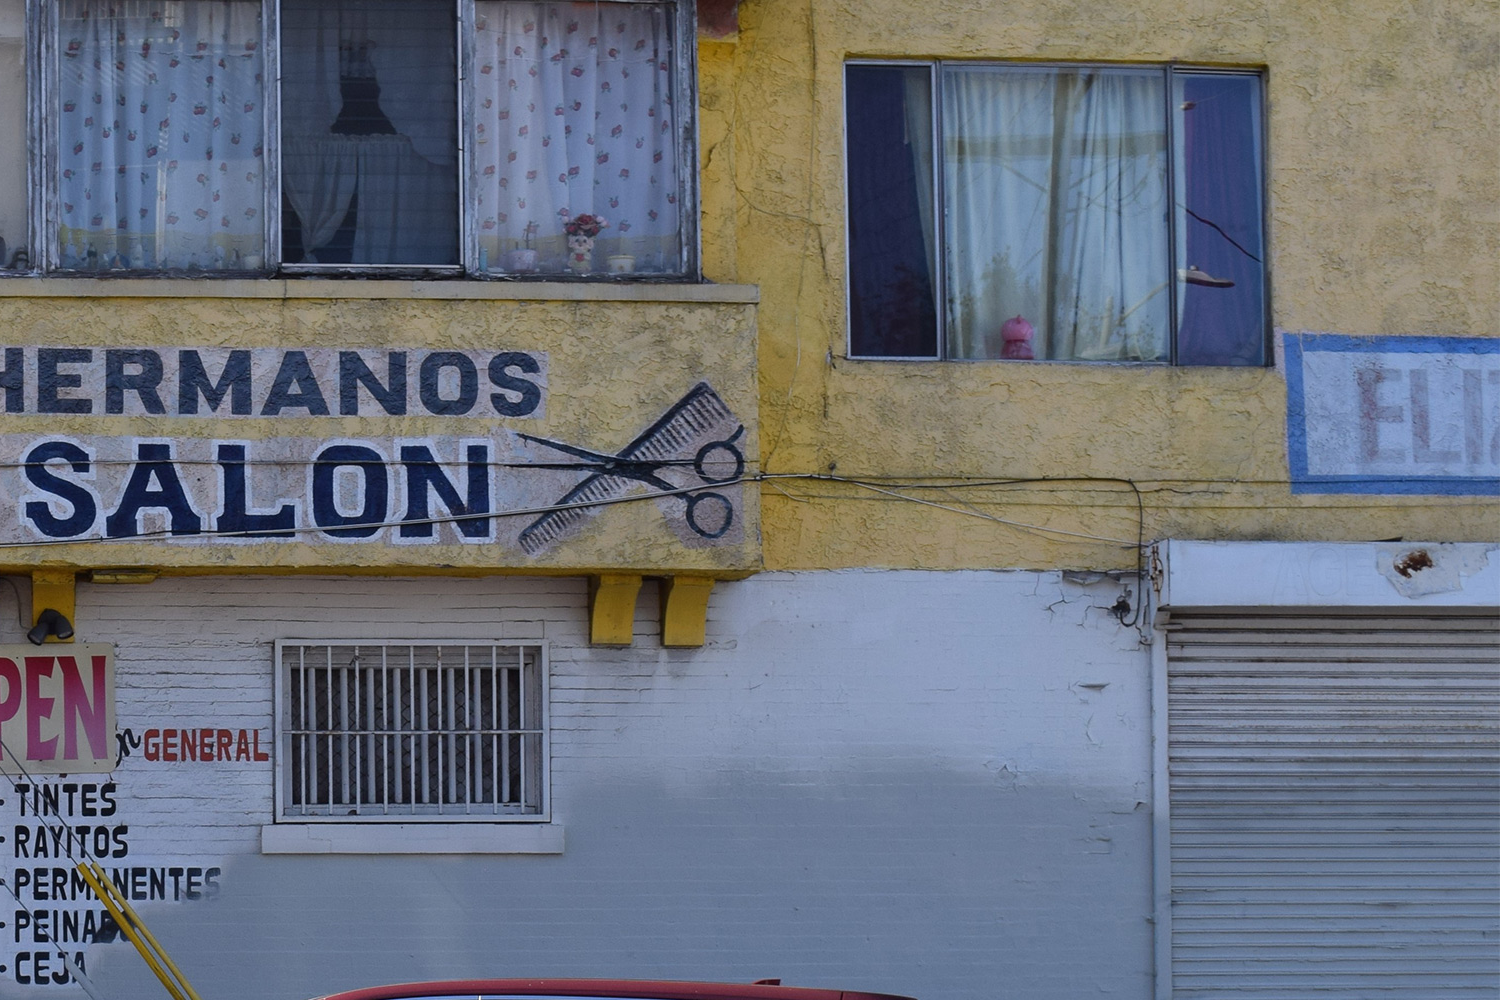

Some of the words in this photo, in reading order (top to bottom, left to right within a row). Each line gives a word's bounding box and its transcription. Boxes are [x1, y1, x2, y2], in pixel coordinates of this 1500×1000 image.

[22, 440, 492, 540] SALON
[143, 728, 269, 762] GENERAL
[14, 783, 117, 817] TINTES
[14, 824, 129, 859] RAYITOS
